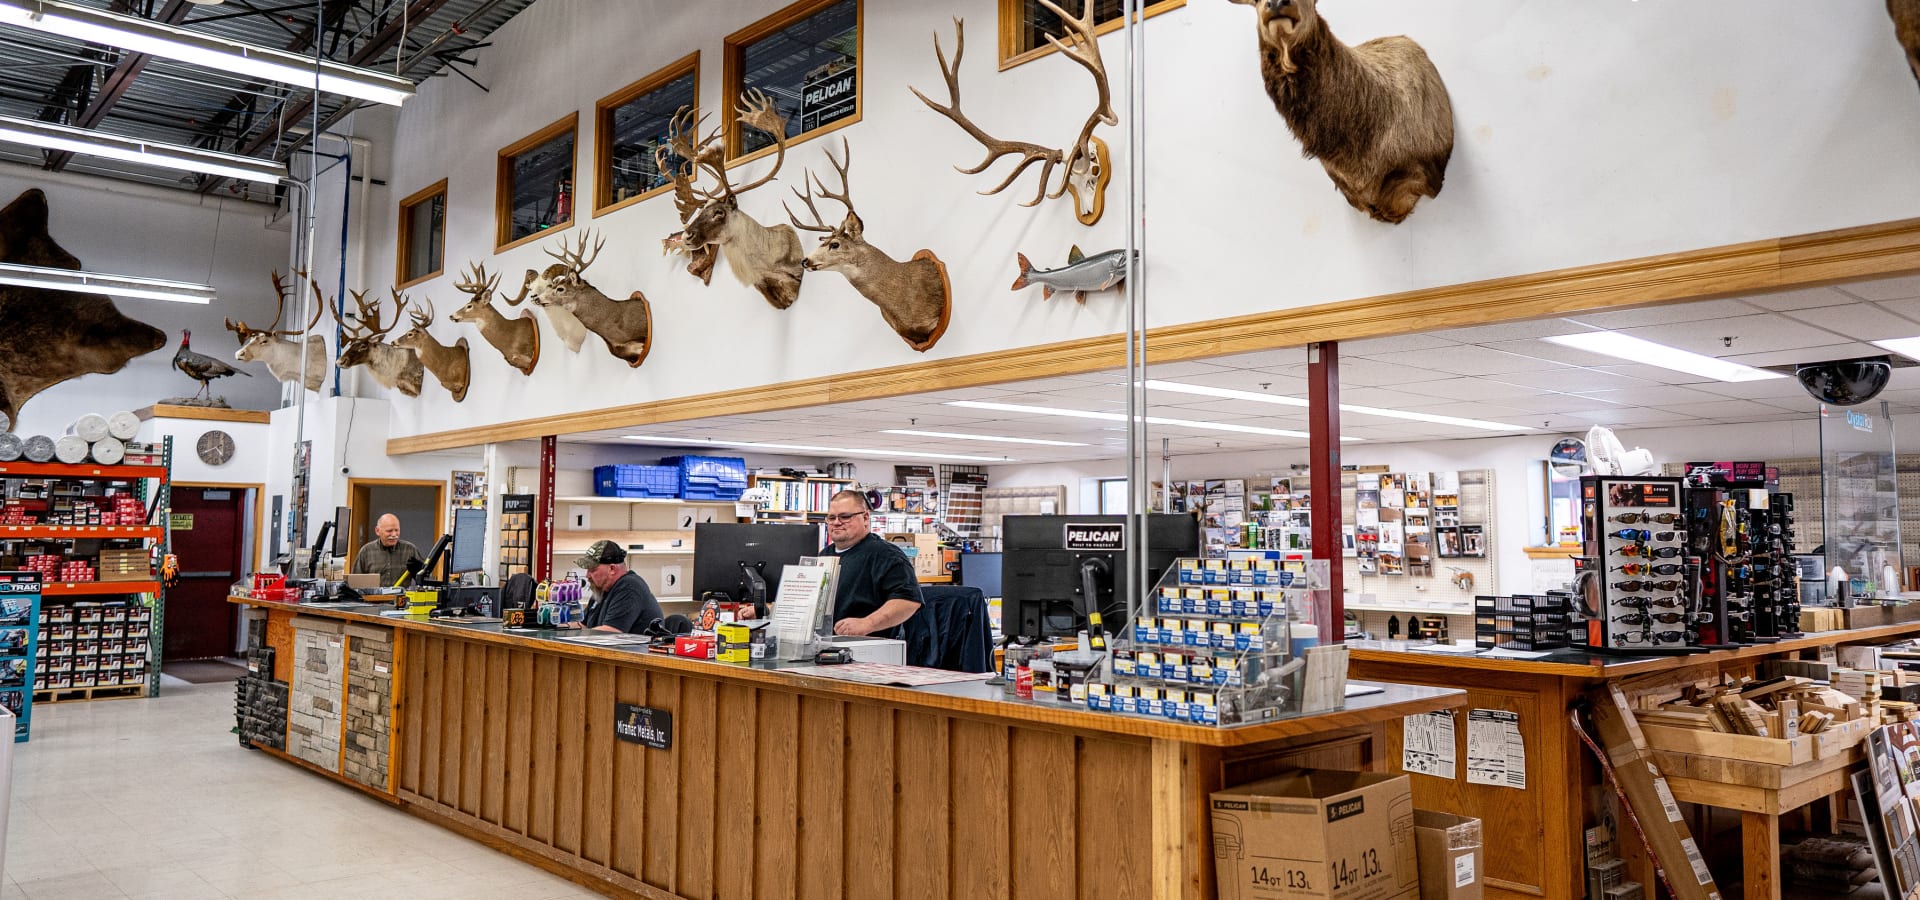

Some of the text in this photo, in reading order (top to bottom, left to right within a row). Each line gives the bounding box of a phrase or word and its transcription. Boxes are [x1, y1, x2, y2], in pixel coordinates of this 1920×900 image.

[804, 76, 852, 107] PELICAN
[576, 514, 583, 526] 1
[682, 515, 692, 528] 2
[1068, 531, 1119, 542] PELICAN
